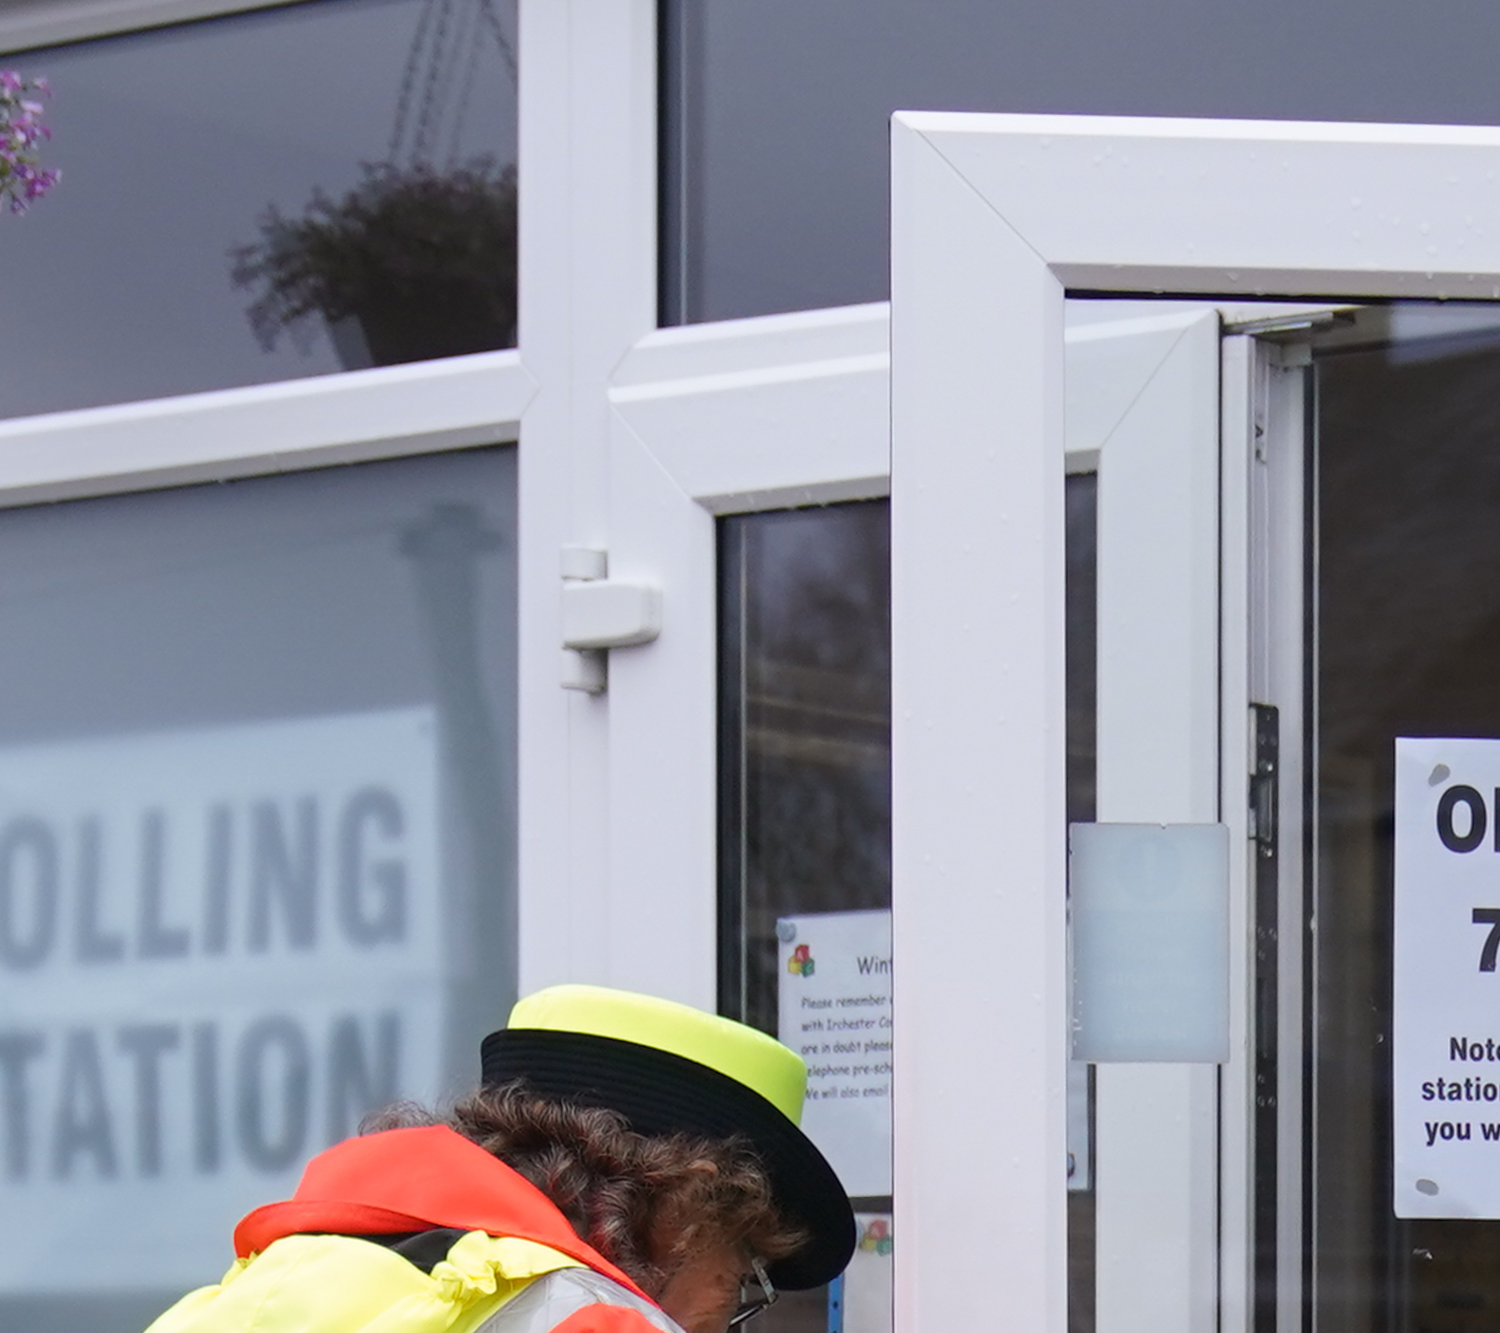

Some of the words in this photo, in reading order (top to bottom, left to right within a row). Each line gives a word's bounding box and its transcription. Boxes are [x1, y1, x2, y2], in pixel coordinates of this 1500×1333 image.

[802, 997, 832, 1009] Please
[836, 995, 887, 1007] remember
[802, 1020, 824, 1032] with
[827, 1018, 876, 1031] Irchester
[801, 1045, 818, 1055] are
[822, 1044, 831, 1053] in
[833, 1042, 861, 1053] doubt
[807, 1065, 850, 1078] elephone
[1425, 1122, 1470, 1146] you
